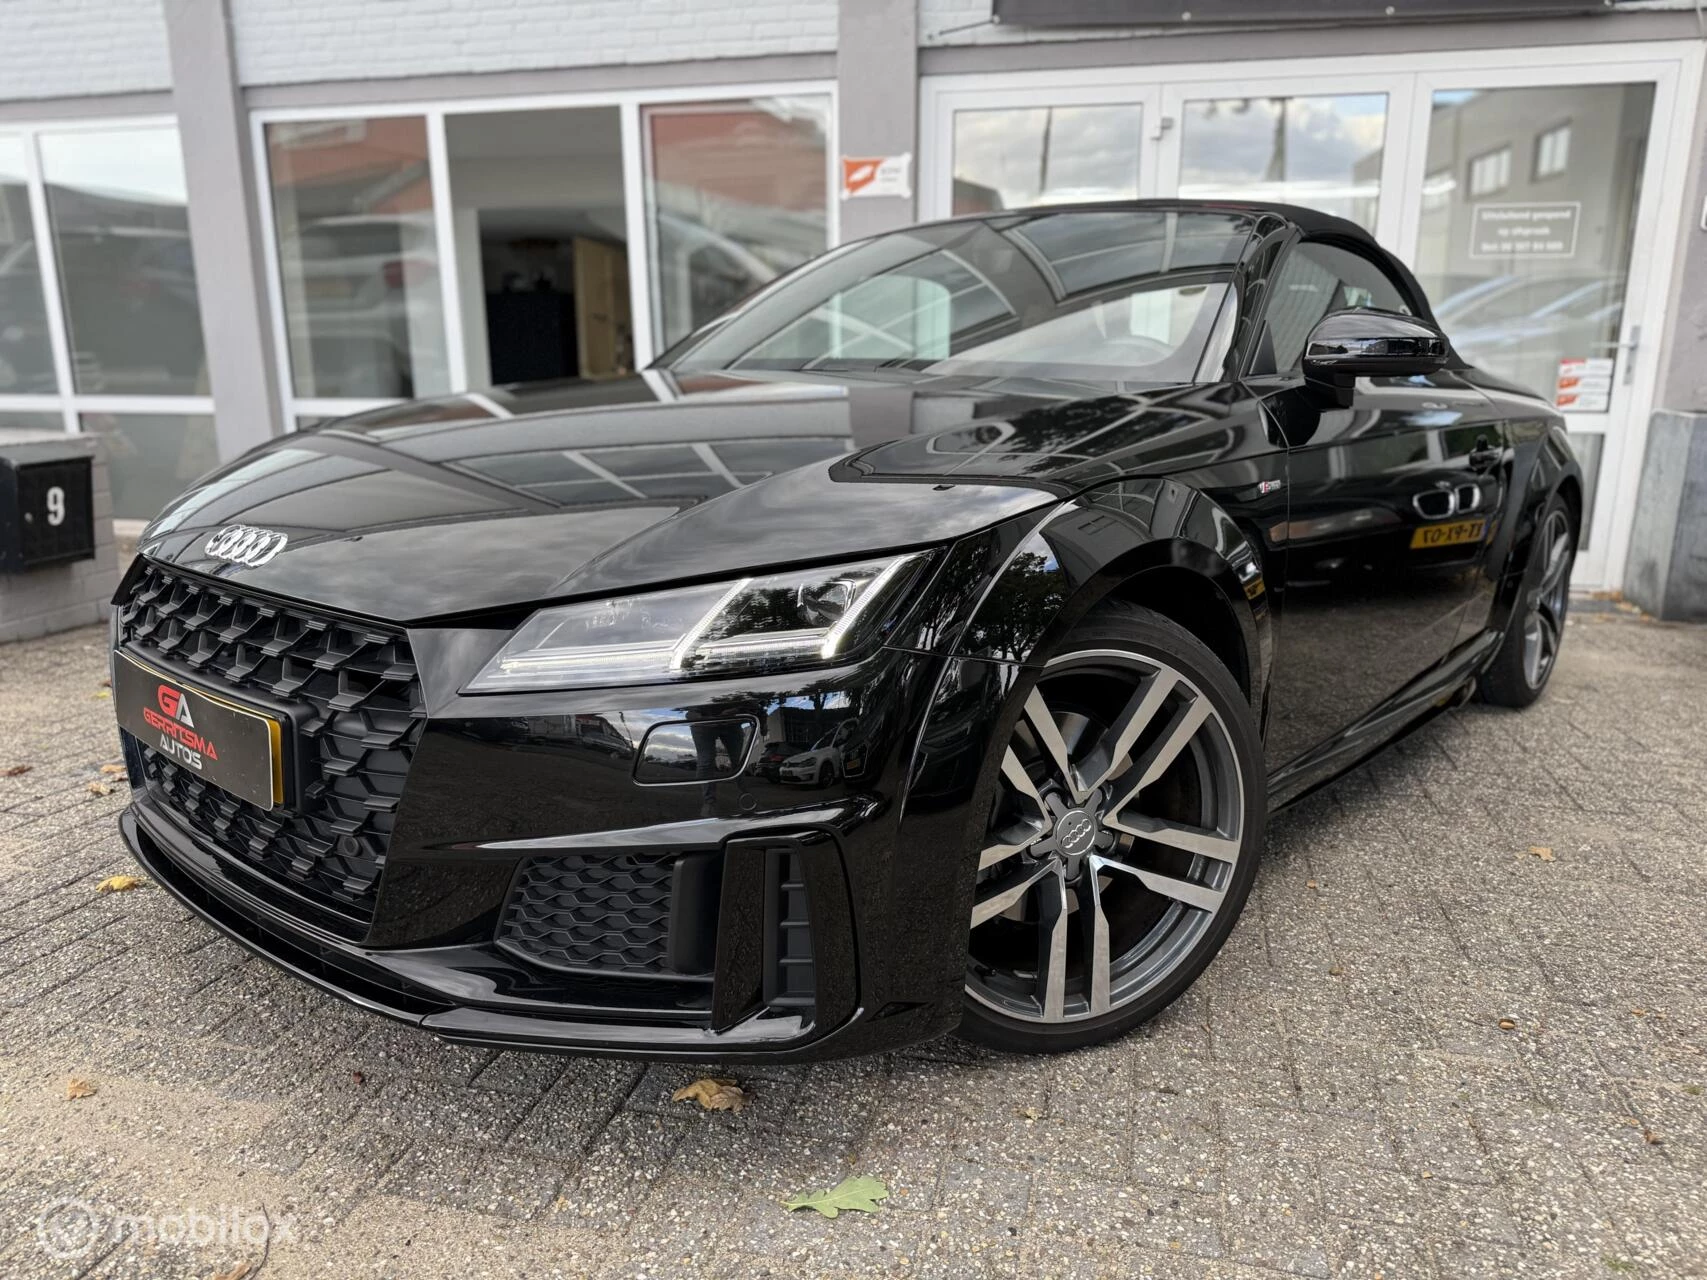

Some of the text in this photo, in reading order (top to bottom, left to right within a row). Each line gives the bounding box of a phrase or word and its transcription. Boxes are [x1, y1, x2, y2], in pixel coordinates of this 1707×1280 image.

[47, 486, 65, 526] 9
[157, 684, 195, 729] GA
[143, 707, 218, 761] GERRITSMA
